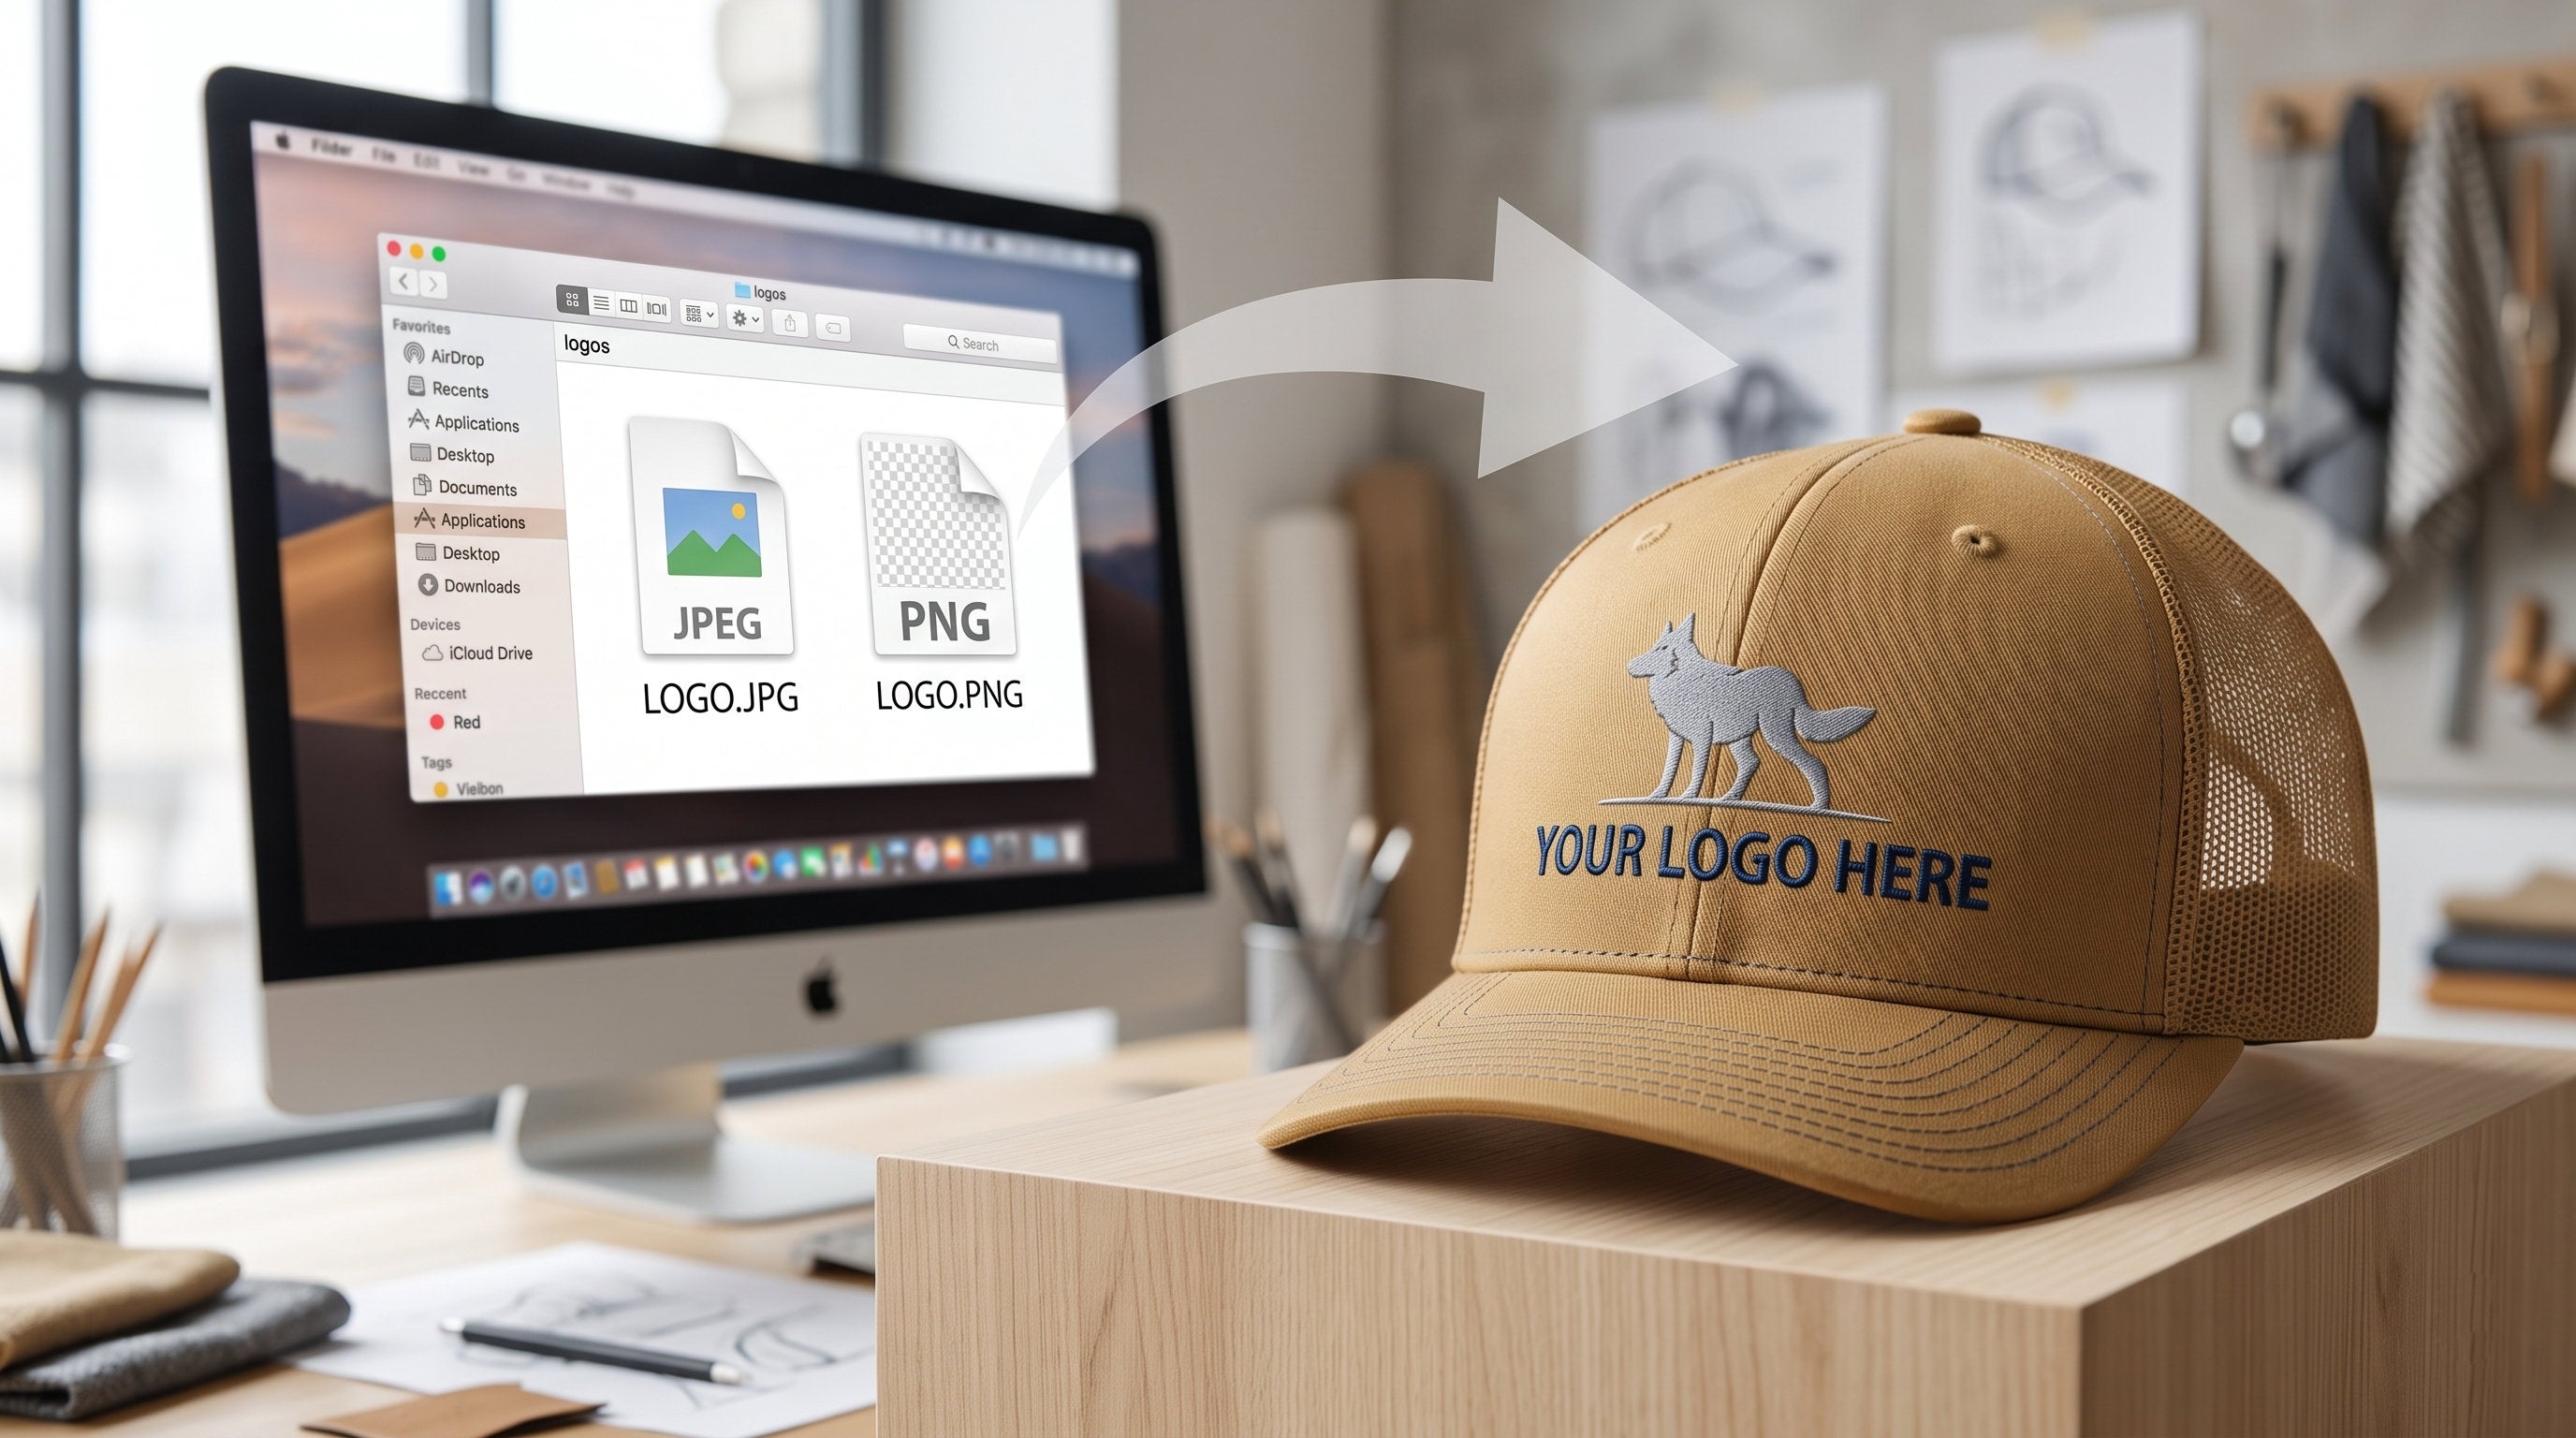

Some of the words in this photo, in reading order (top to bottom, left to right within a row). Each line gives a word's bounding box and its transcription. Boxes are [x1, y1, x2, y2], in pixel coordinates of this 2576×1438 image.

[754, 286, 786, 301] logos
[392, 318, 451, 335] Favorites
[564, 334, 610, 356] logos
[963, 337, 1000, 353] Search
[432, 349, 485, 368] AirDrop
[433, 381, 489, 399] Recents
[435, 415, 520, 433] Applications
[438, 447, 495, 466] Desktop
[440, 479, 518, 497] Documents
[442, 513, 526, 530] Applications
[444, 546, 501, 565] Desktop
[446, 579, 521, 594] Downloads
[411, 618, 461, 631] Devices
[674, 606, 762, 640] JPEG
[900, 600, 991, 642] PNG
[450, 646, 494, 660] iCloud
[498, 646, 534, 660] Drive
[415, 687, 467, 700] Reccent
[644, 682, 799, 714] LOGO.JPG
[877, 679, 1024, 711] LOGO.PNG
[454, 715, 481, 729] Red
[421, 756, 452, 771] Tags
[1536, 824, 1646, 877] YOUR
[1658, 825, 1819, 889] LOGO
[1834, 839, 1992, 912] HERE
